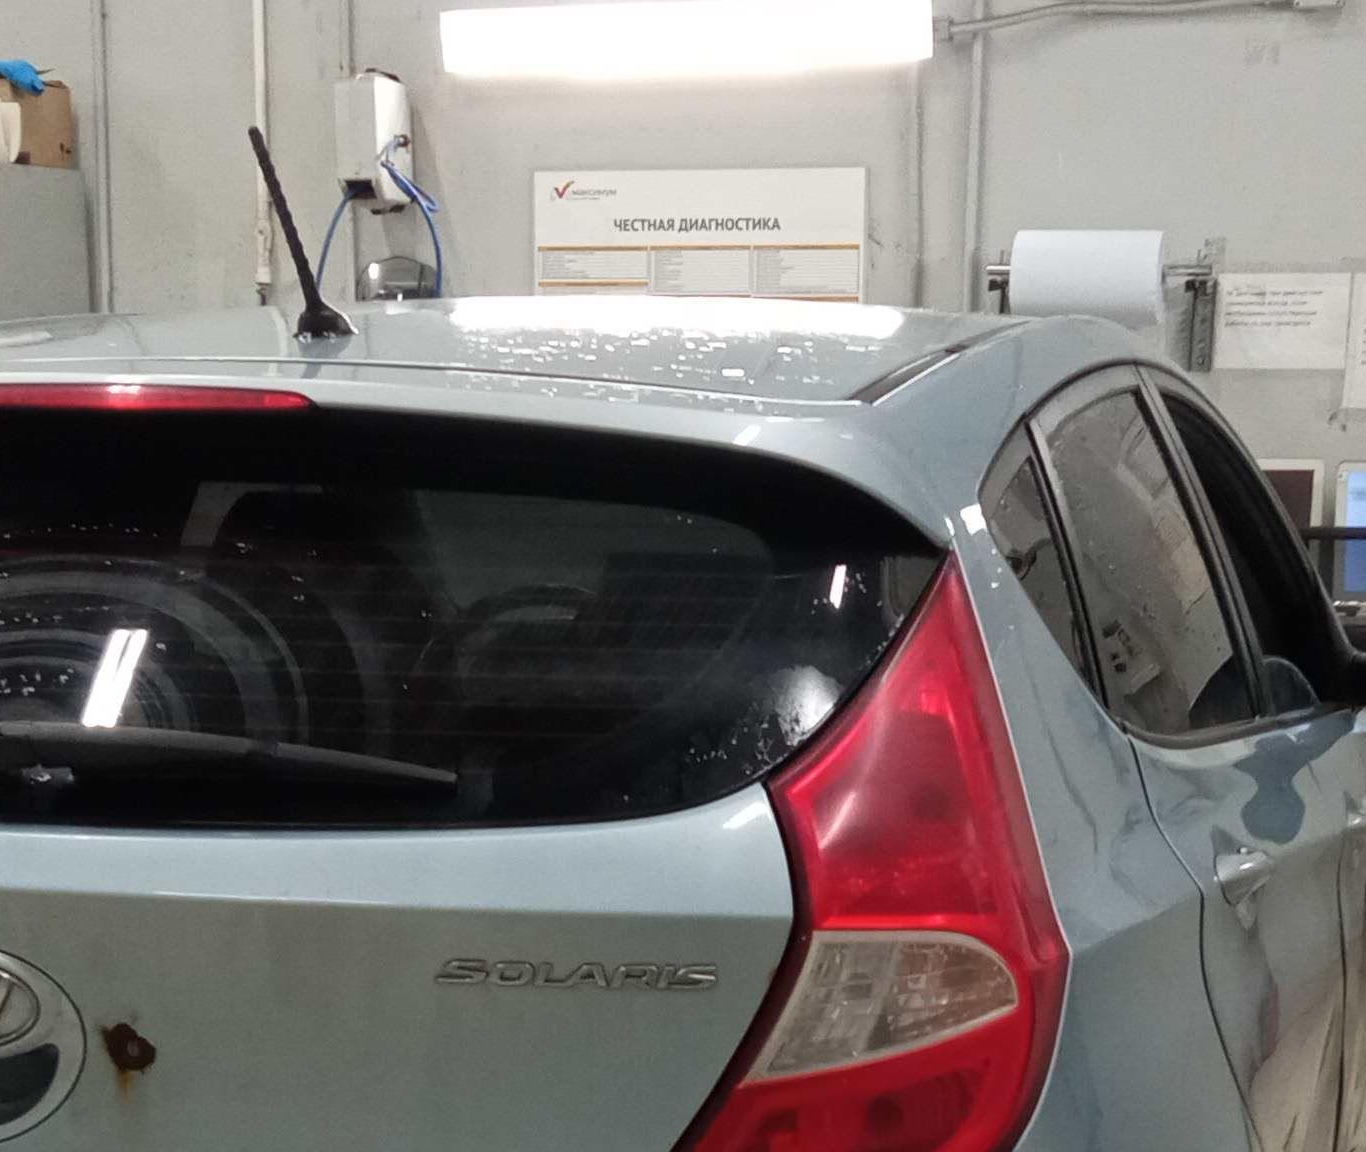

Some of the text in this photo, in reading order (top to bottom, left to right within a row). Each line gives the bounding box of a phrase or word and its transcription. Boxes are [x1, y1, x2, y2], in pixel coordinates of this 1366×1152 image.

[613, 216, 782, 233] ЧЕСТНАЯ ДИАГНОСТИКА
[434, 957, 717, 992] SOLARIS
